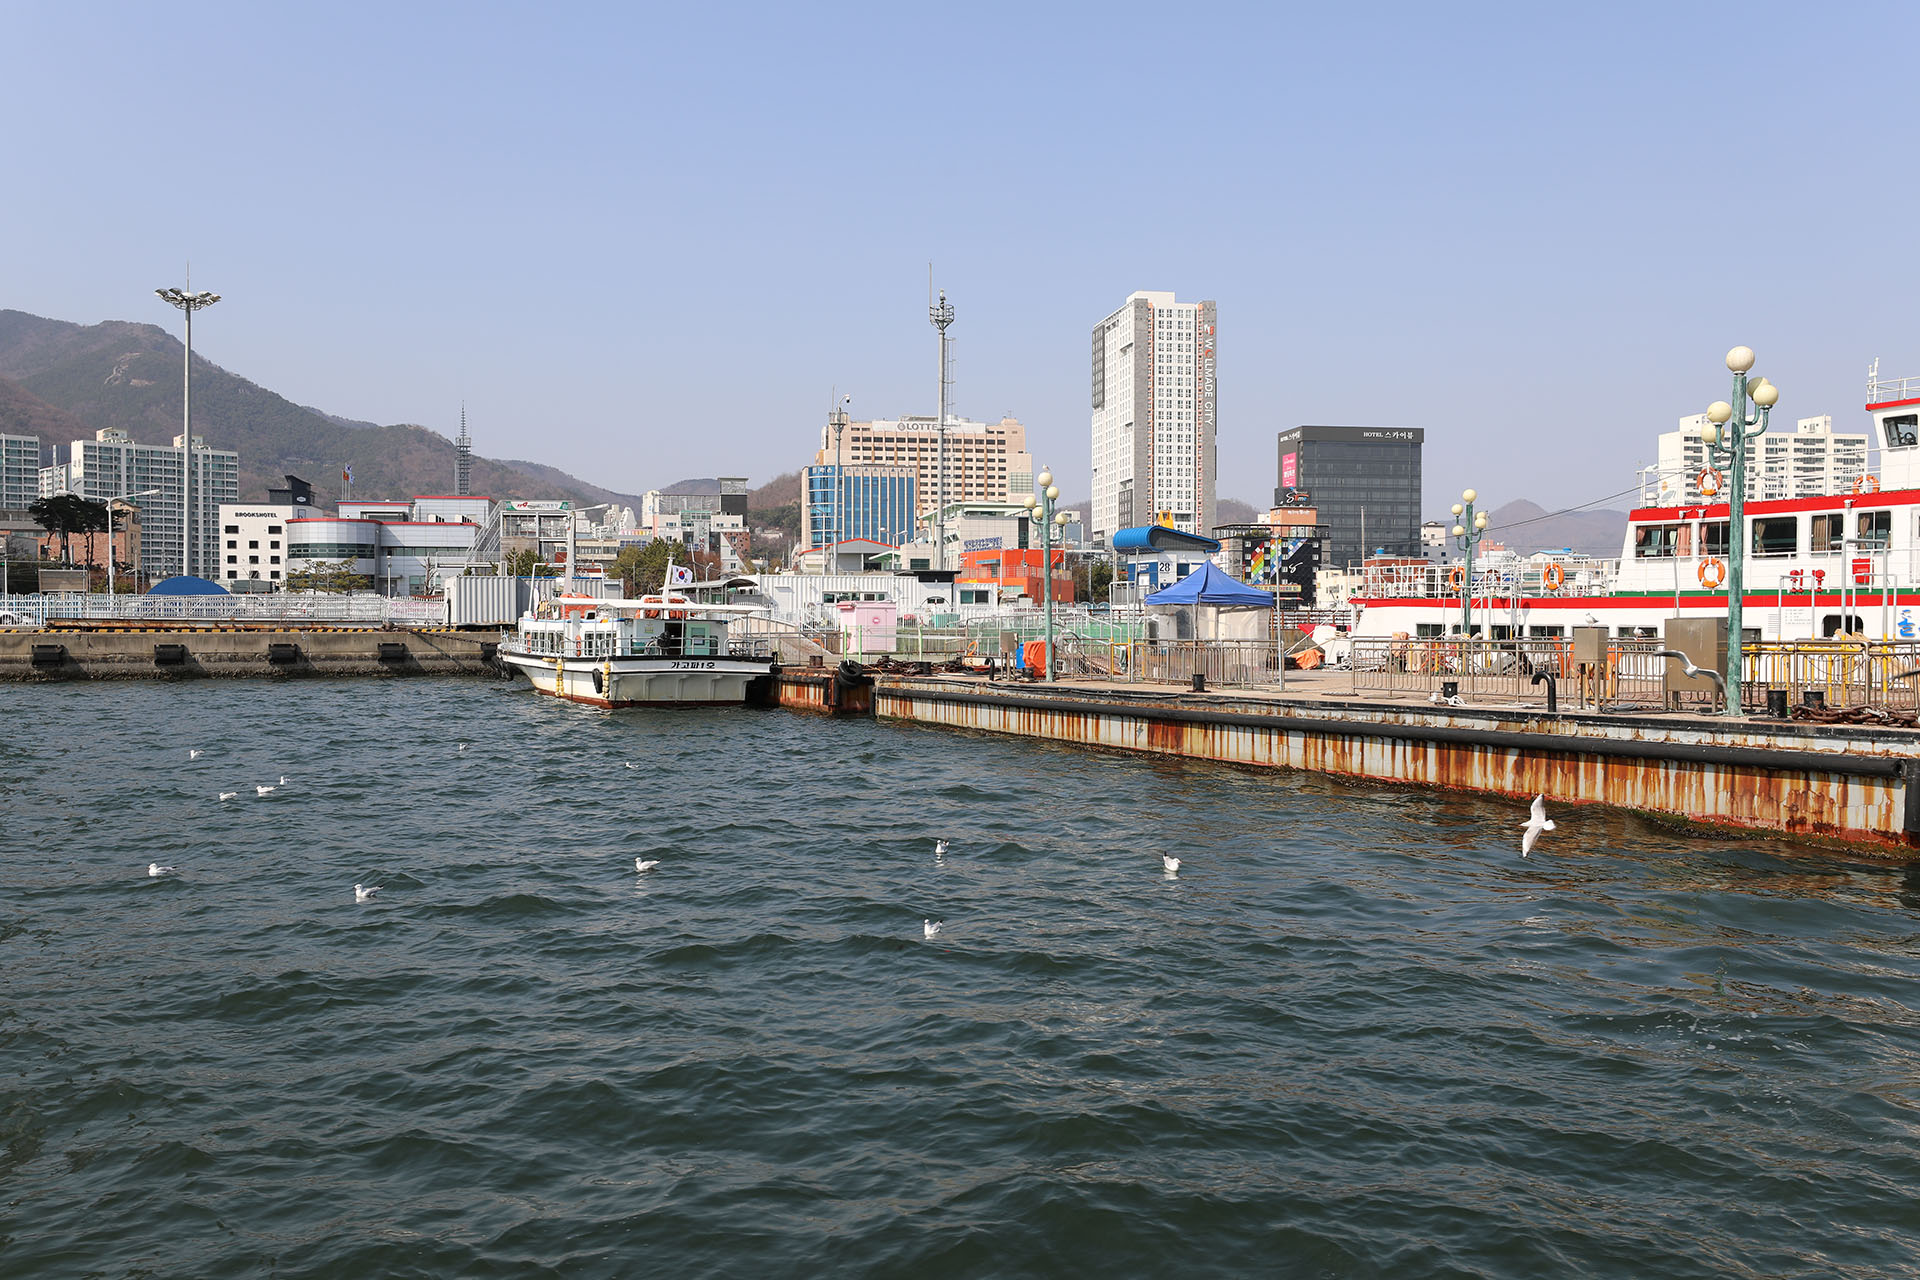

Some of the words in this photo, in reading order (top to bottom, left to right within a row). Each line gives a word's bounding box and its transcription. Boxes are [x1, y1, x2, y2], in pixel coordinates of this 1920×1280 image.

[1204, 401, 1213, 425] CITY
[906, 423, 938, 431] LOTTE
[1159, 562, 1171, 572] 28
